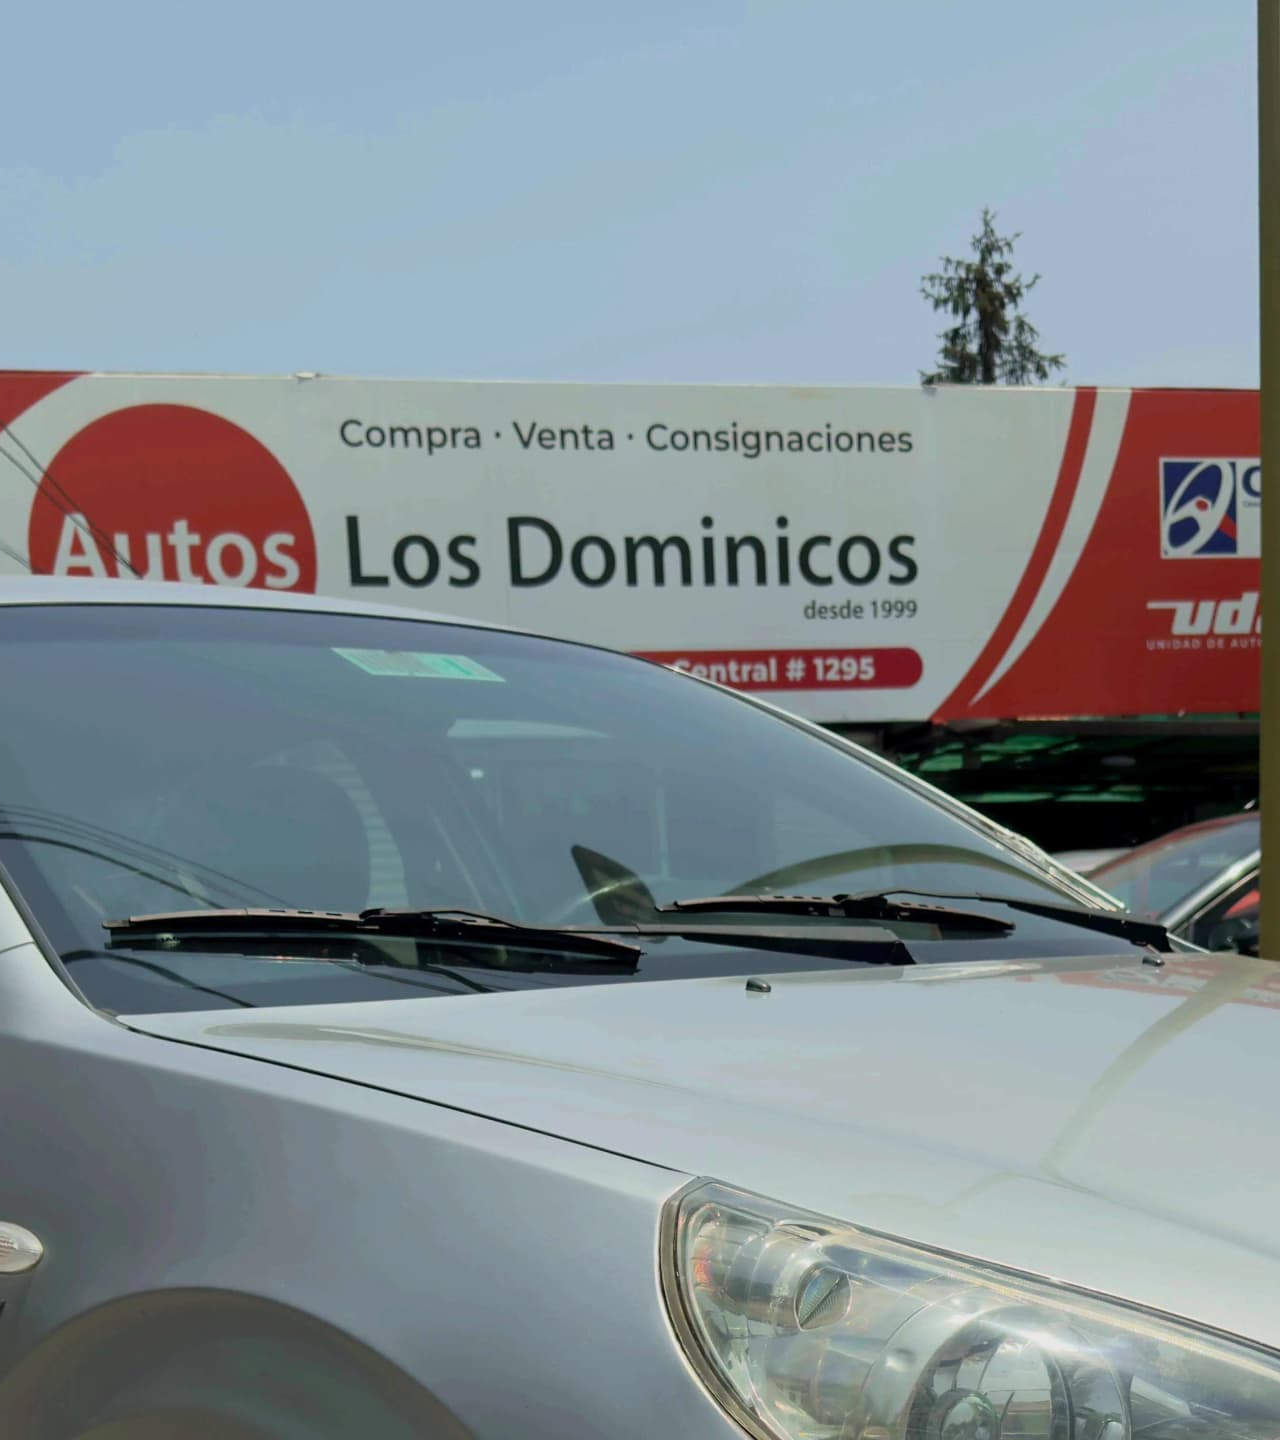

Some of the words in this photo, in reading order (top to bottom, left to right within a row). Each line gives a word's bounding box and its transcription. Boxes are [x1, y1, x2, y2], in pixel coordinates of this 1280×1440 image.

[340, 419, 482, 454] Compra
[513, 421, 616, 451] Venta
[646, 423, 914, 459] Consignaciones
[53, 510, 300, 589] Autos
[346, 514, 481, 588] Los
[506, 514, 919, 588] Dominicos
[804, 600, 864, 619] desde
[871, 600, 918, 619] 1999
[1146, 639, 1201, 651] UNIDAD
[1207, 638, 1224, 650] DE
[813, 656, 875, 681] 1295
